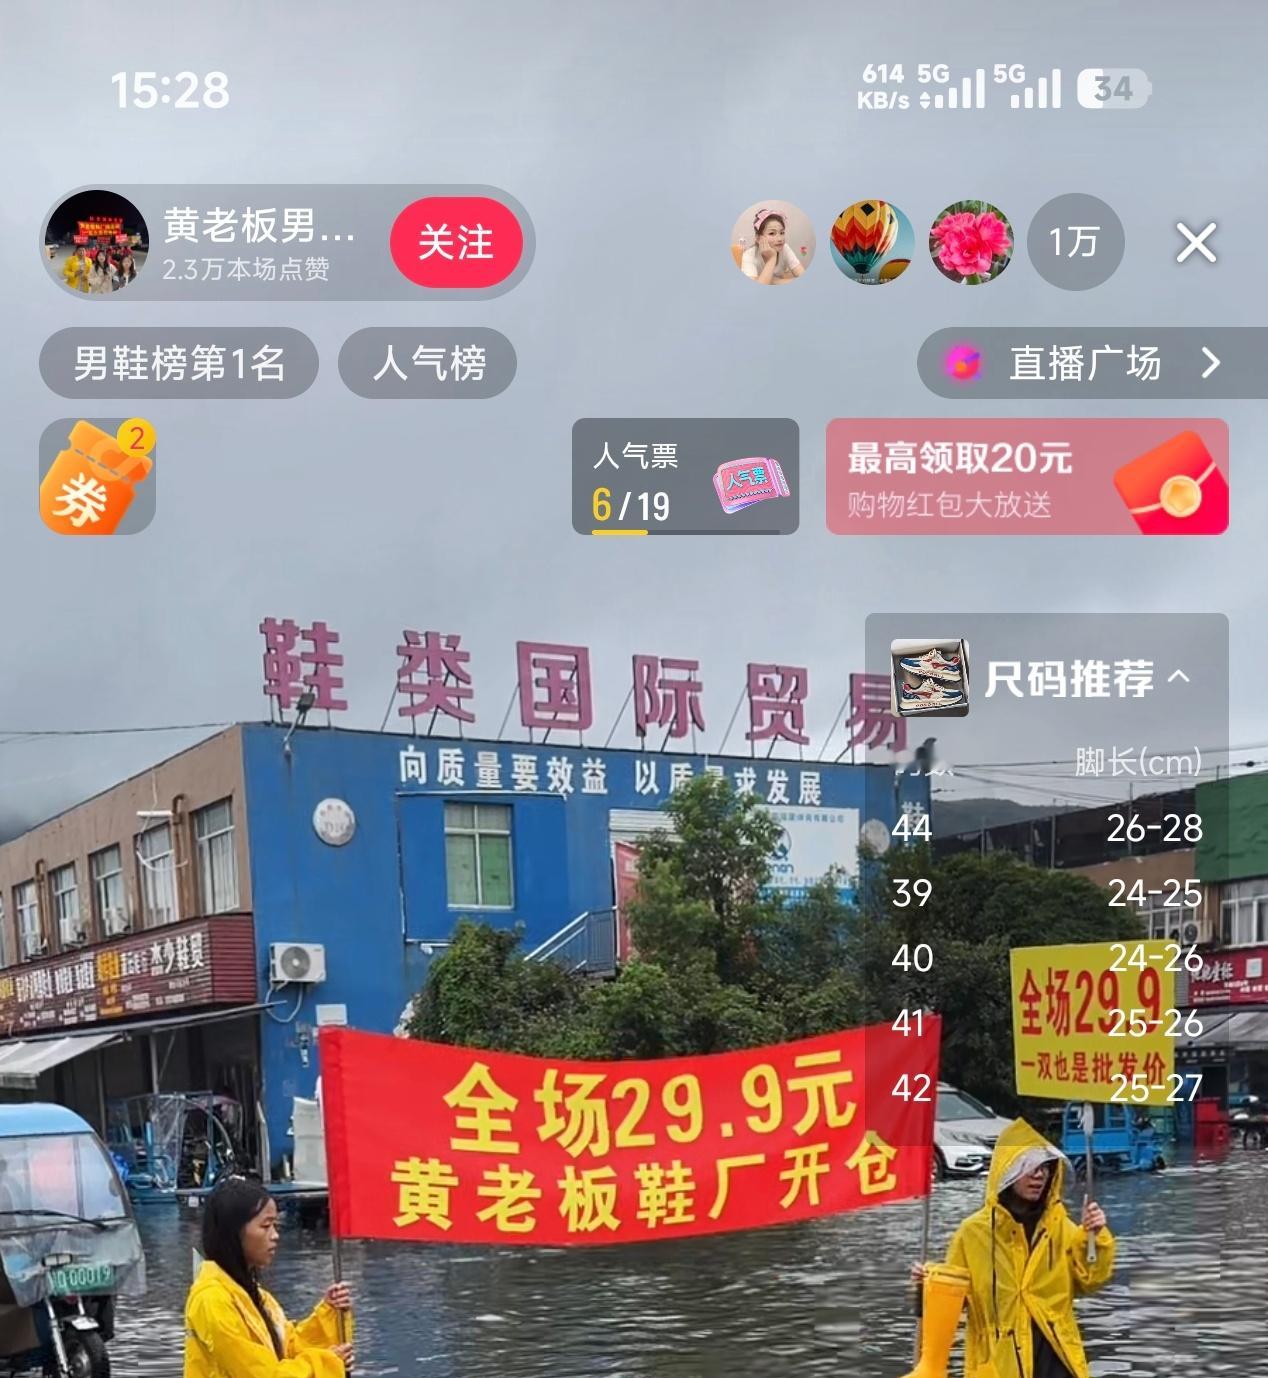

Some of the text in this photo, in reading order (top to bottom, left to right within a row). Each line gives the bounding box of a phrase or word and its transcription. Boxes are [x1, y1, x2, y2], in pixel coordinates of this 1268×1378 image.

[260, 617, 907, 752] 鞋类国际贸易
[400, 744, 822, 806] 向质量要效益 以质求发展
[443, 1050, 857, 1158] 全场29.9元
[1021, 1050, 1166, 1086] 一双也是批发价
[391, 1130, 898, 1233] 黄老板鞋厂开仓
